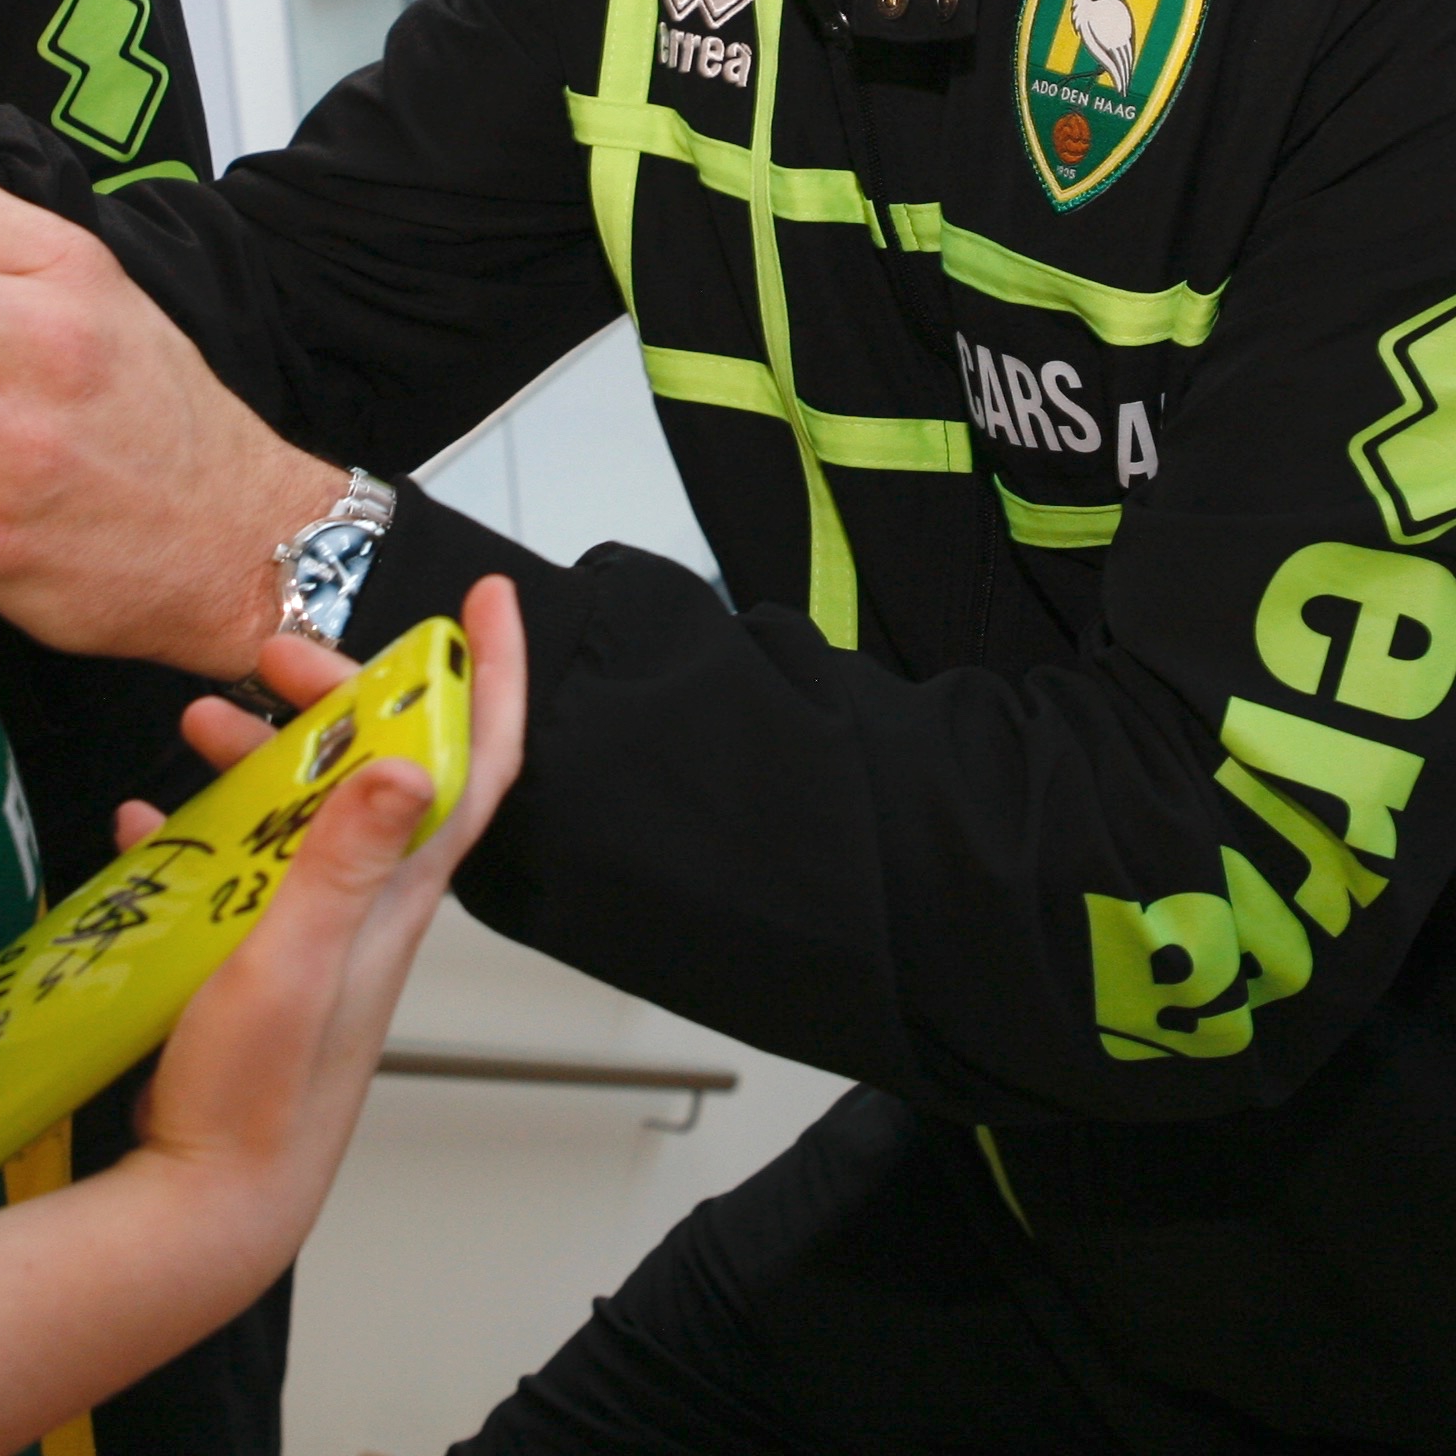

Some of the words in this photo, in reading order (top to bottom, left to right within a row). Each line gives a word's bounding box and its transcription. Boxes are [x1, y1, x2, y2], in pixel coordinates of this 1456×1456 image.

[1031, 79, 1058, 97] ADO
[1061, 86, 1089, 106] DEN
[1093, 96, 1136, 119] HAAG
[956, 331, 1102, 453] CARS
[1117, 392, 1165, 489] A
